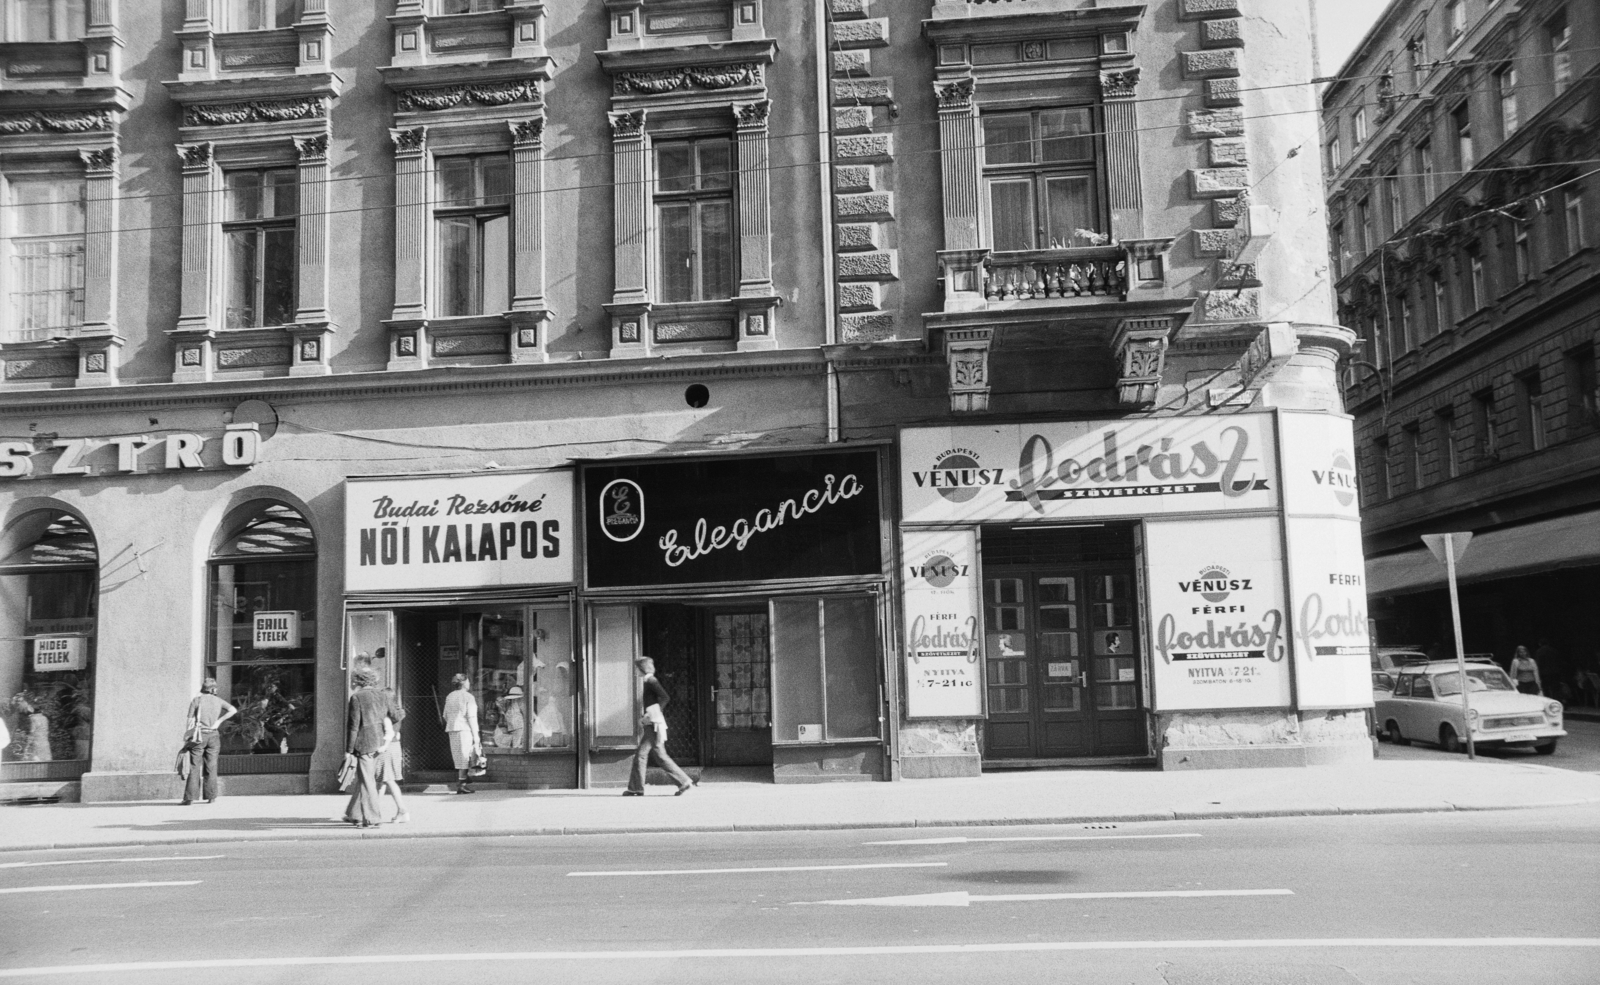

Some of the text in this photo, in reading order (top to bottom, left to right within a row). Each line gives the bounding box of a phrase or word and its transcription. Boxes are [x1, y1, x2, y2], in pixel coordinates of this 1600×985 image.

[936, 447, 980, 461] BUDAPESTI
[912, 464, 1005, 487] VÉNUSZ
[1063, 484, 1197, 498] SZÖVETKEZET
[373, 493, 547, 519] Budai Rezsőné
[659, 474, 864, 567] Elegancia
[360, 519, 560, 567] NŐI KALAPOS
[910, 563, 969, 578] VÉNUSZ
[1199, 565, 1231, 576] BUDAPESTI
[1178, 579, 1253, 592] VÉNUSZ
[1192, 604, 1246, 614] FÉRFI
[930, 611, 957, 621] FÉRFI
[257, 618, 288, 630] GRILL
[256, 630, 288, 642] ÉTELEK
[39, 639, 68, 651] HIDEG
[1186, 651, 1249, 660] SZÖVETKEZET
[923, 669, 965, 677] NYITVA
